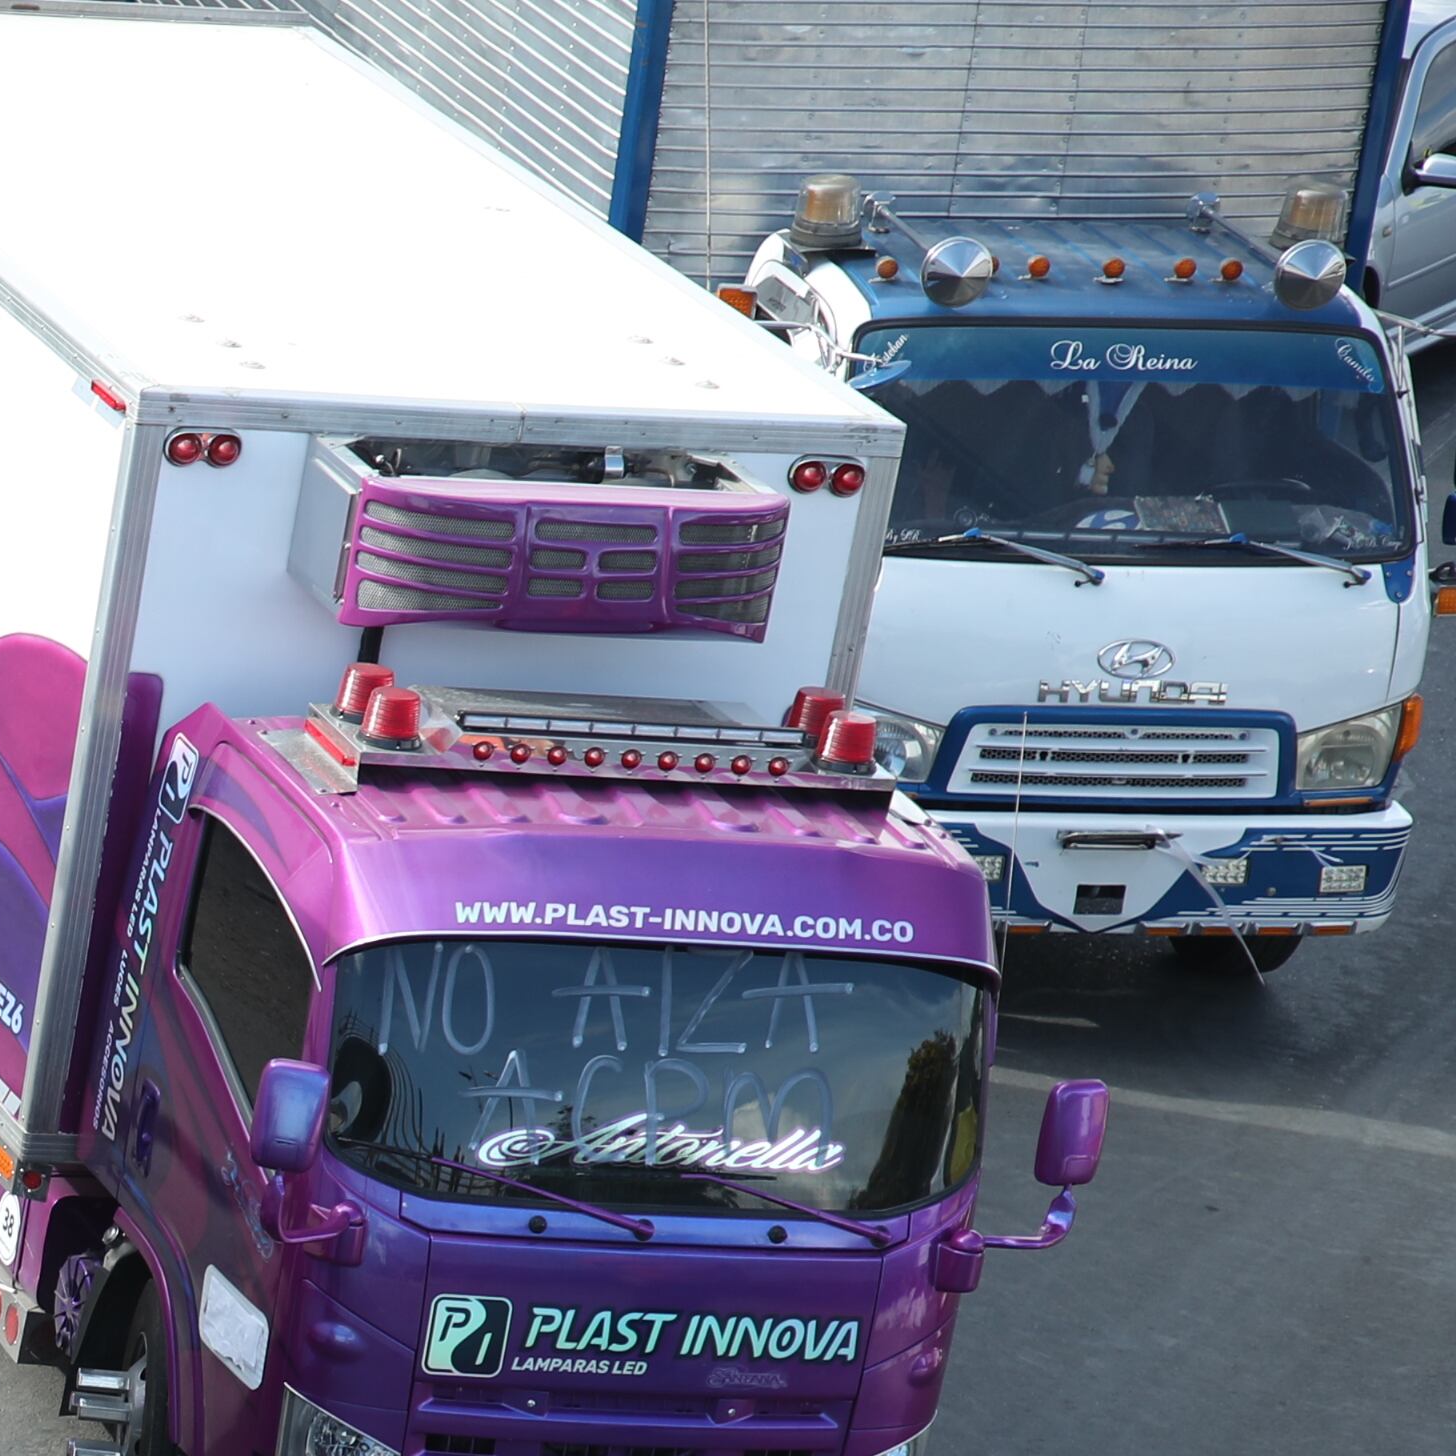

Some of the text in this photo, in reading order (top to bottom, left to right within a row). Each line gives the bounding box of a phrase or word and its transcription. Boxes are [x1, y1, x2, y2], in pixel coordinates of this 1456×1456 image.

[1050, 340, 1198, 372] La Reina
[1335, 338, 1382, 392] Camilo
[1038, 680, 1229, 704] HYUNDAI
[126, 904, 138, 938] LED
[134, 827, 173, 976] PLAST
[456, 901, 914, 943] WWW.PLAST-INNOVA.COM.CO
[113, 948, 129, 1007] LUCES
[378, 942, 495, 1055] NO
[92, 1018, 115, 1131] ACCESORIOS
[101, 976, 142, 1142] INNOVA
[459, 1048, 833, 1167] ACPM
[477, 1112, 846, 1172] Antonella
[2, 1207, 14, 1238] 38
[525, 1307, 677, 1354] PLAST
[680, 1315, 860, 1362] INNOVA
[511, 1357, 648, 1376] LAMPARAS LED
